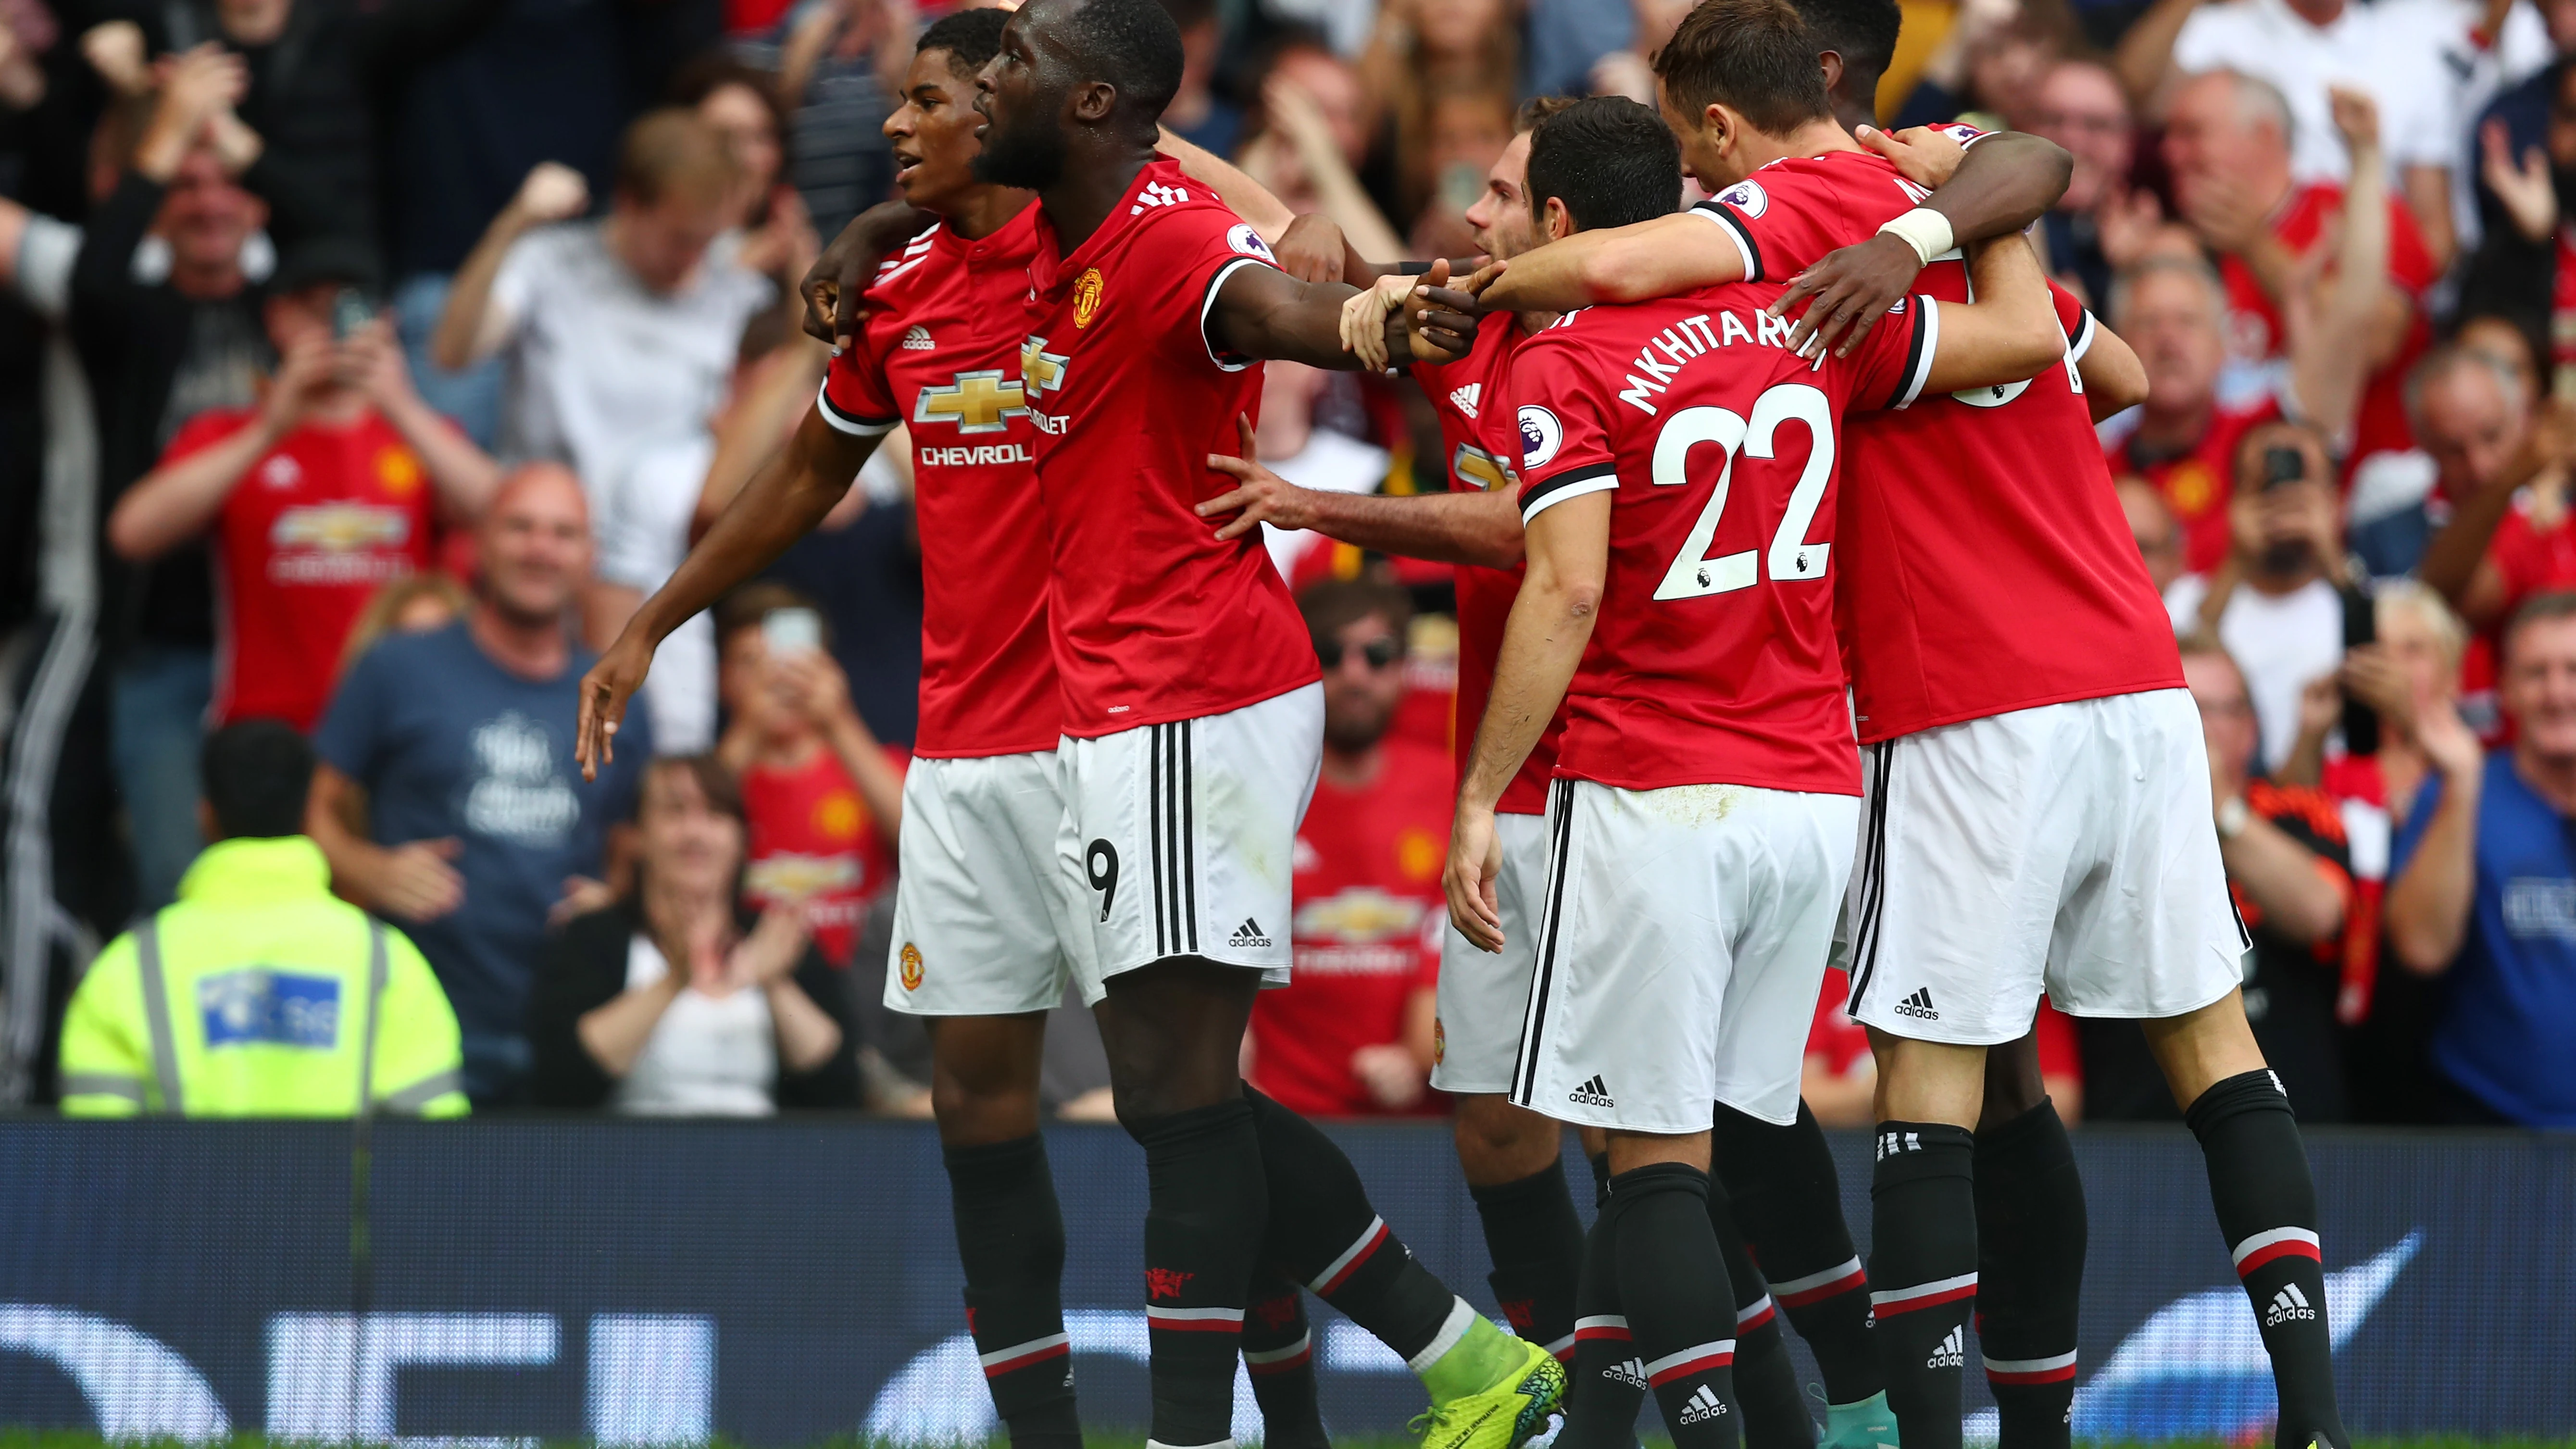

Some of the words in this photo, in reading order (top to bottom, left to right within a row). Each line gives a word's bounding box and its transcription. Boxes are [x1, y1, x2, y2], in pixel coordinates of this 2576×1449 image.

[1651, 382, 1835, 601] 22
[1087, 837, 1119, 923] 9
[1228, 936, 1272, 947] adidas
[1894, 1004, 1939, 1020] adidas
[1569, 1092, 1614, 1108] adidas
[2266, 1305, 2315, 1327] adidas
[1602, 1369, 1648, 1391] adidas
[1679, 1403, 1727, 1425] adidas
